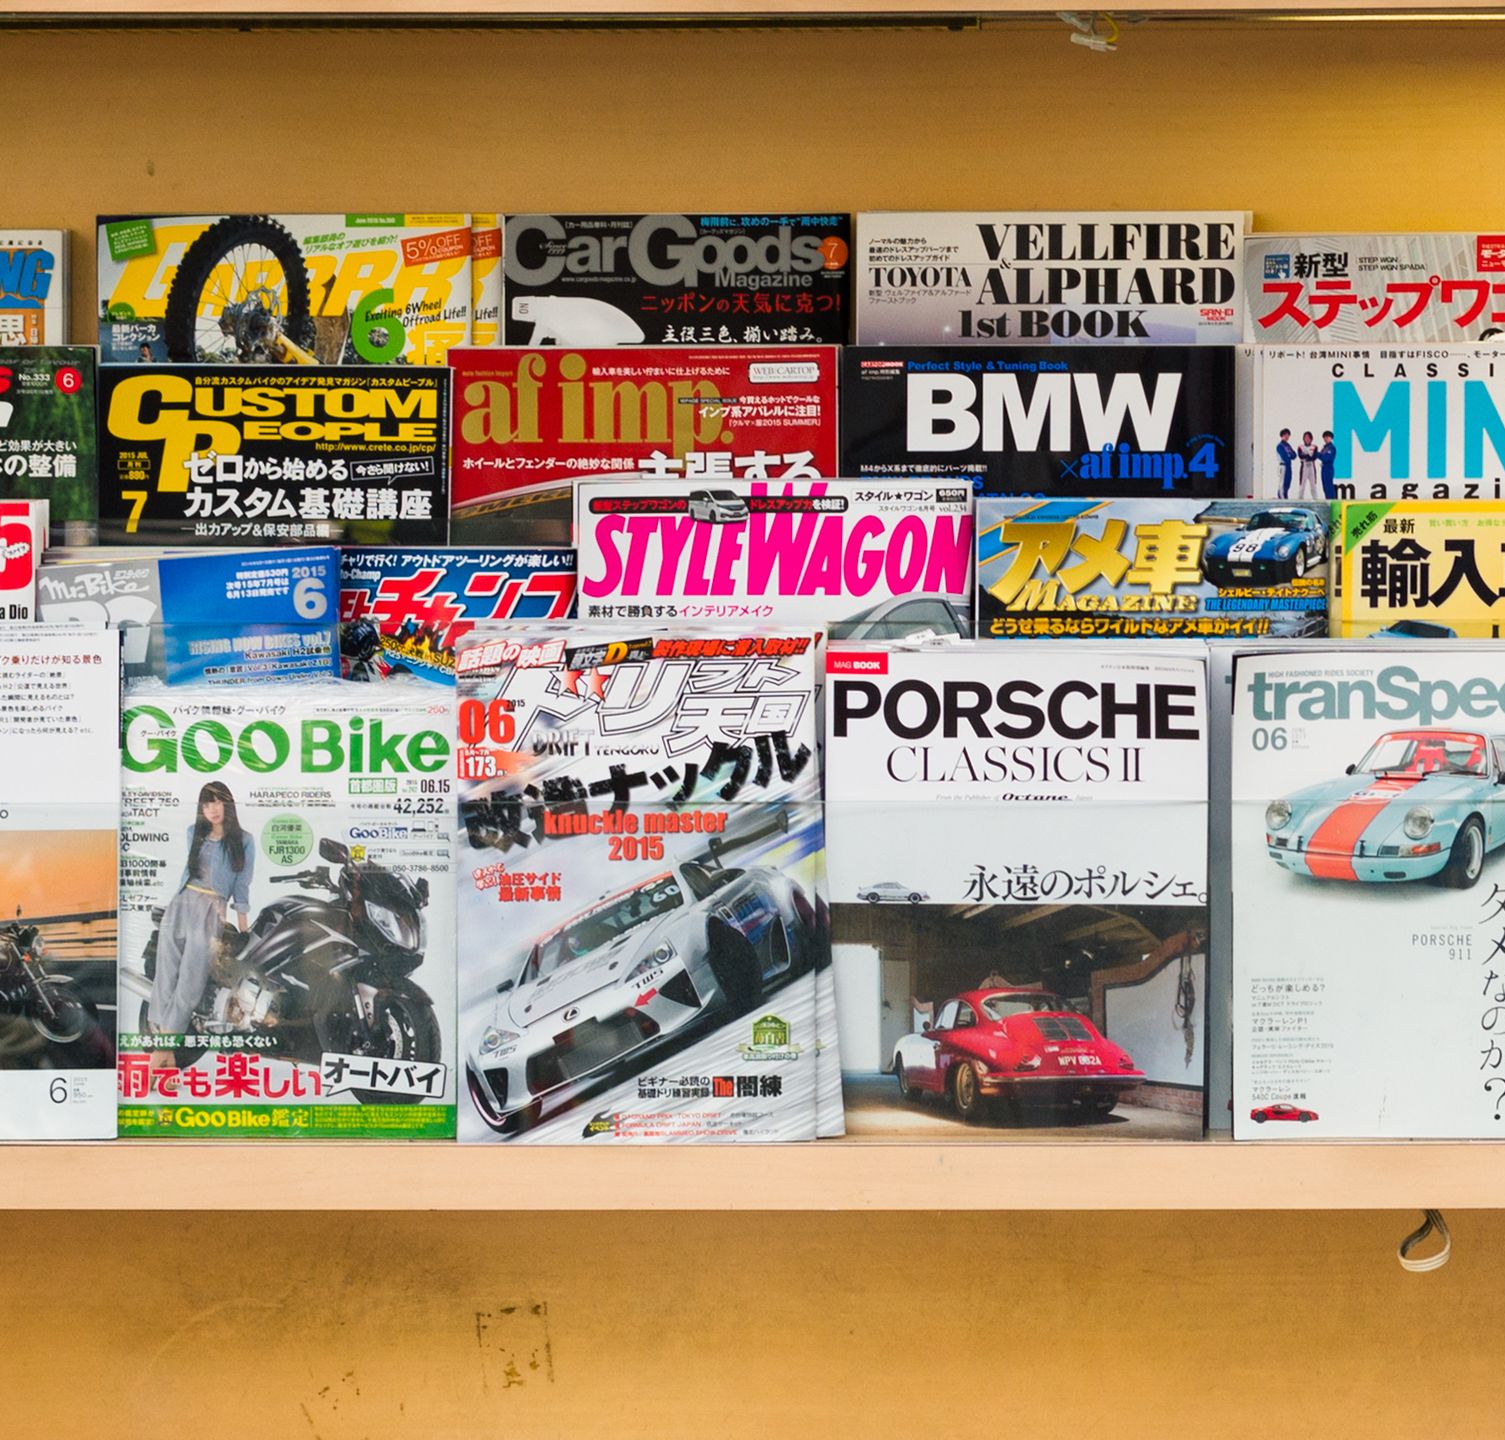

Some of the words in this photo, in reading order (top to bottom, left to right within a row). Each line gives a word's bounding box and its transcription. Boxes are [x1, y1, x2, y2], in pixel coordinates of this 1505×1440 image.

[976, 223, 1235, 261] VELLFIRE
[869, 267, 972, 288] TOYOTA
[1294, 253, 1349, 278] 新型
[714, 270, 813, 290] Magazine
[977, 267, 1235, 306] ALPHARD
[641, 294, 841, 314] ニッポンの天気に克つ!
[958, 310, 1011, 338] 1st
[1019, 309, 1150, 339] BOOK
[908, 361, 951, 371] Perfect
[953, 361, 982, 373] Style
[997, 361, 1036, 373] Tuning
[1039, 361, 1068, 371] Book
[906, 372, 1182, 452] BMW
[183, 452, 349, 484] ゼロから始める
[463, 457, 635, 470] ホイールとフェンダーの絶妙な関係
[183, 488, 432, 520] カスタム基礎講座
[1007, 579, 1196, 612] MAGAZINE
[8, 604, 28, 620] Dio
[588, 605, 774, 618] 素材で勝負するインテリアメイク
[990, 618, 1270, 635] どうせ乗るならワイルドなアメ車がイイ!!
[833, 680, 1199, 741] PORSCHE
[886, 746, 1111, 783] CLASSICS
[544, 811, 639, 835] knuckle
[644, 811, 728, 834] master
[608, 837, 664, 861] 2015
[963, 864, 1208, 903] 永遠のポルシェ。
[1412, 935, 1473, 946] PORSCHE
[1449, 949, 1473, 960] 911
[324, 1056, 437, 1094] オートバイ
